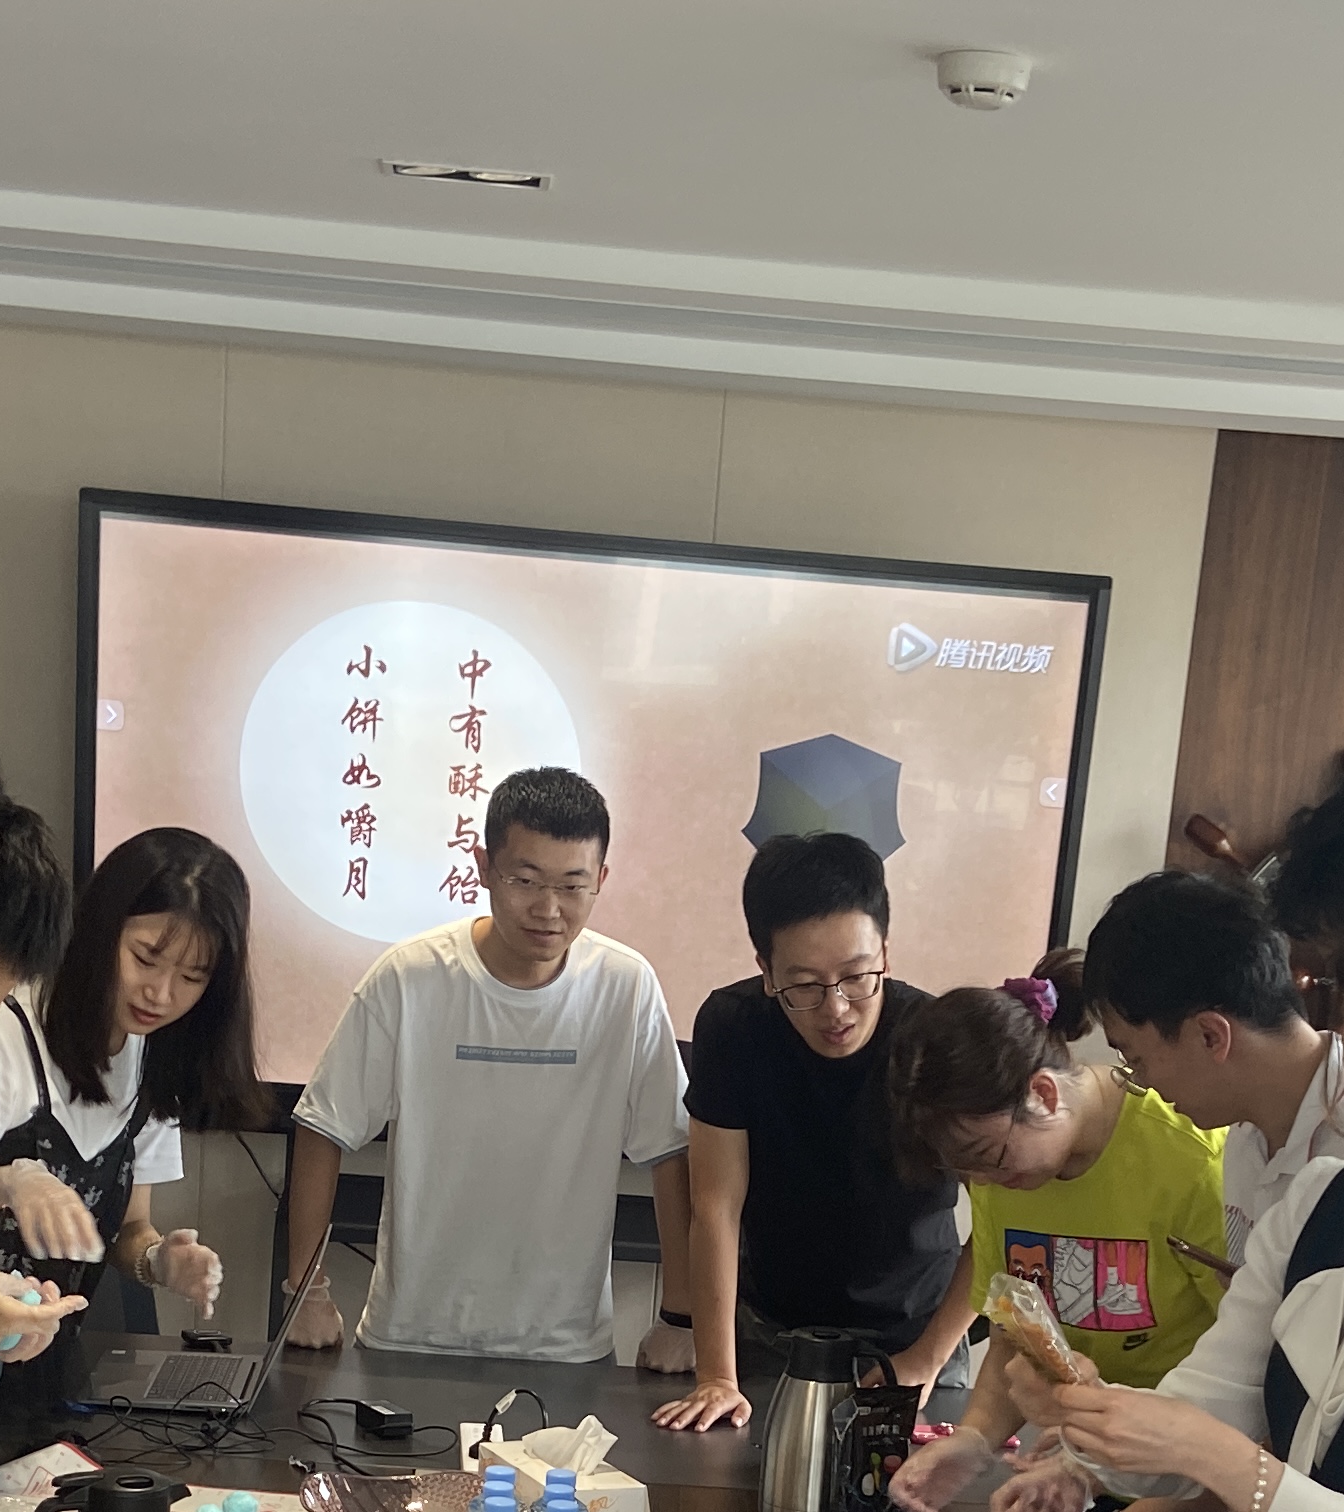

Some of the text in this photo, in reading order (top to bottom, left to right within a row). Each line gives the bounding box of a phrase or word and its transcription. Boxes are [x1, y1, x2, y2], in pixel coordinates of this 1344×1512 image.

[340, 644, 387, 901] 小饼如嚼月
[439, 649, 492, 905] 中有酥与饴
[934, 637, 1055, 674] 腾讯视频
